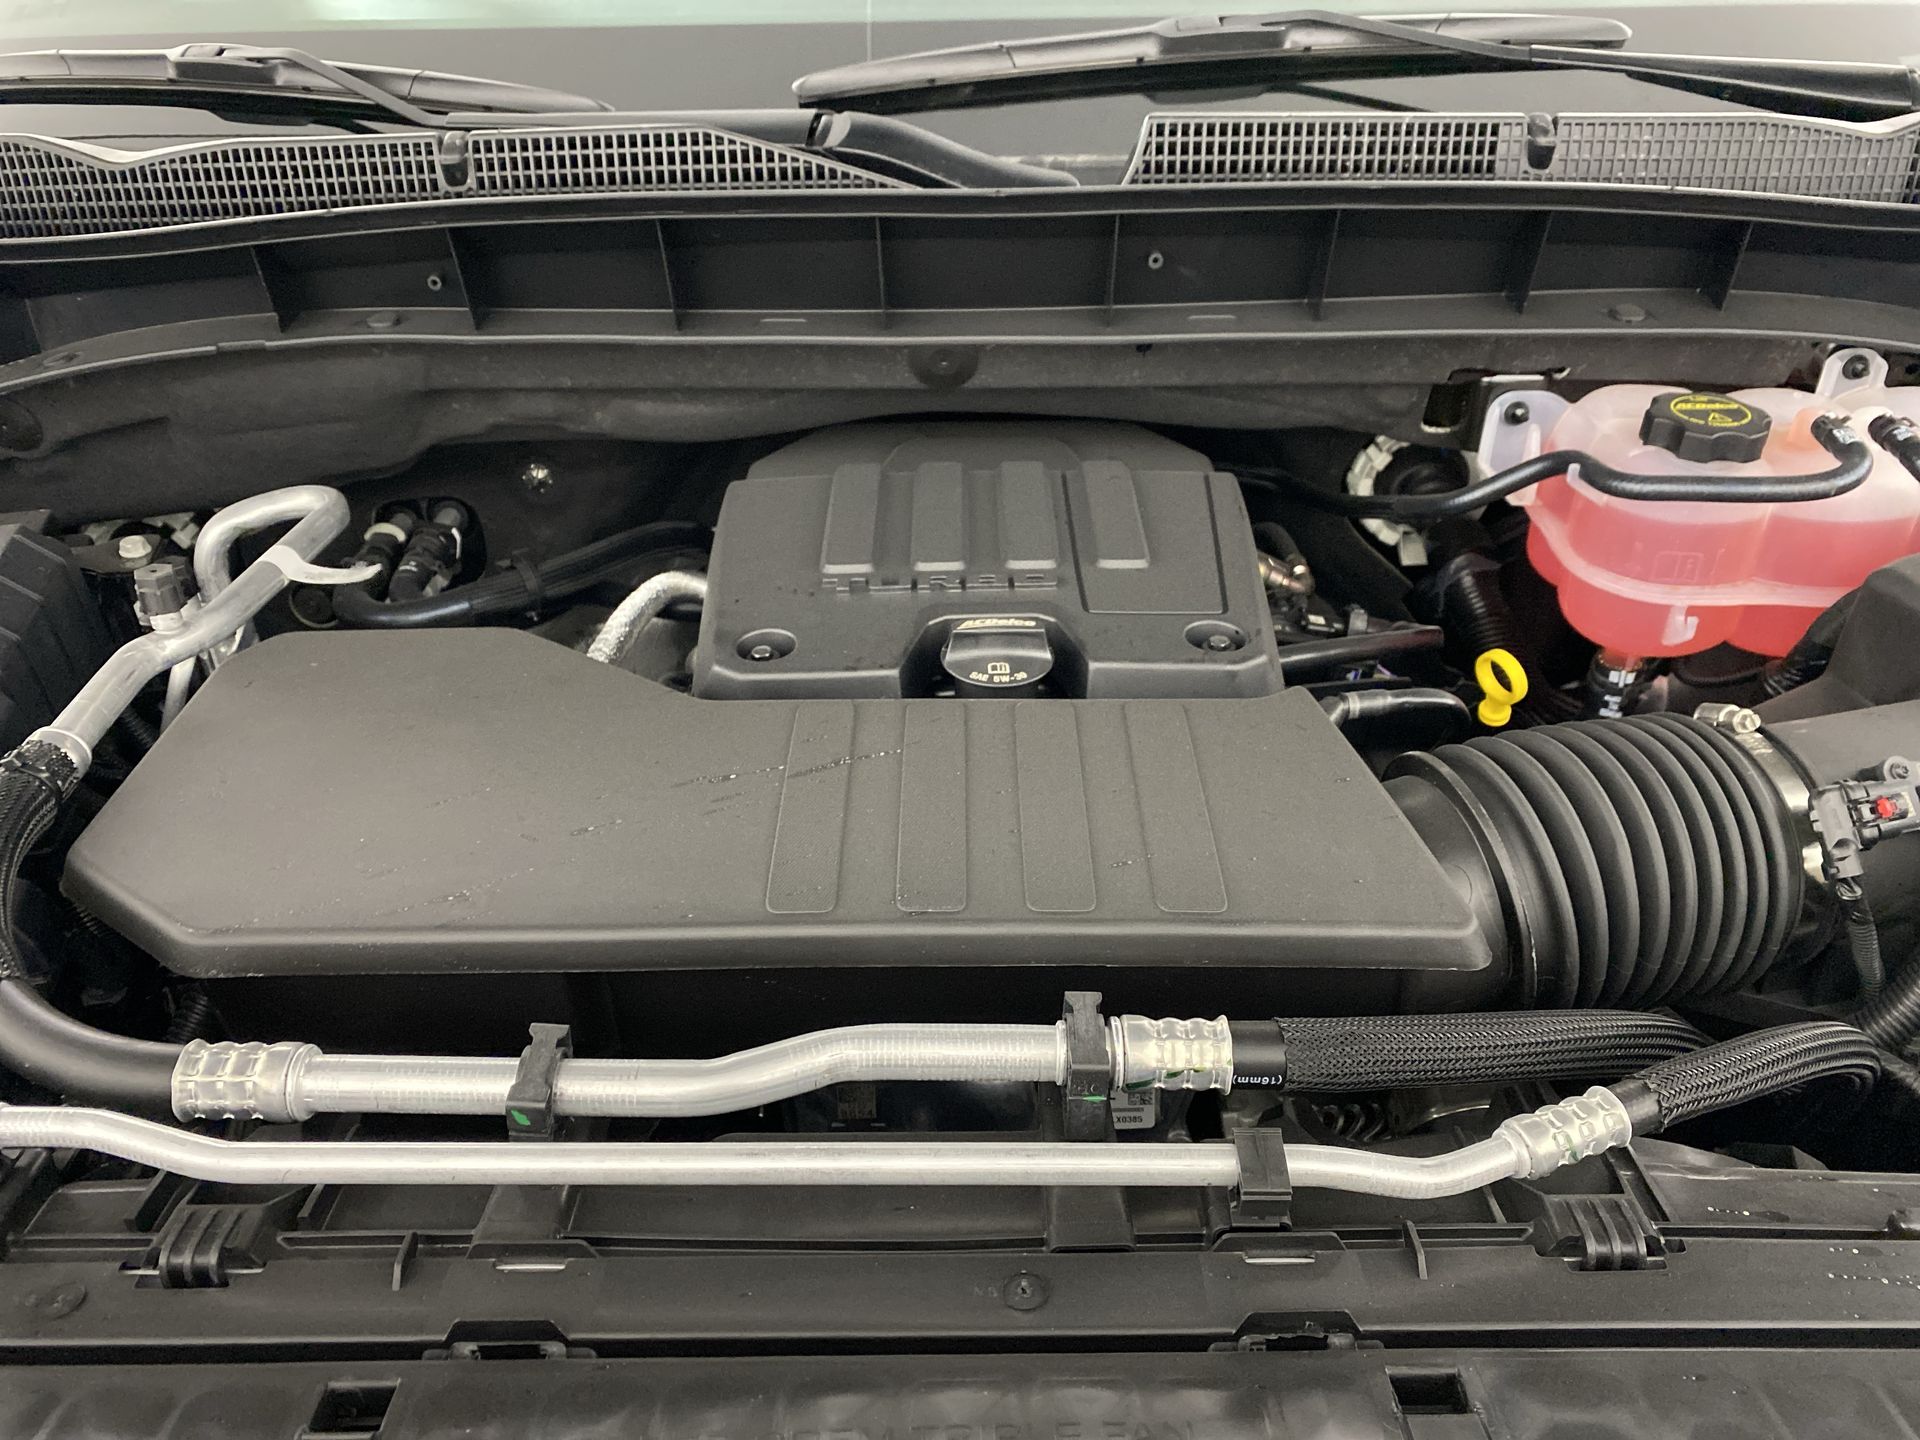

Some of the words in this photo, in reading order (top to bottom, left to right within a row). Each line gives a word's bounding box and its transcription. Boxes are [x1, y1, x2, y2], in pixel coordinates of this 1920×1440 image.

[957, 618, 1037, 629] ACDelco
[969, 671, 990, 682] SAE
[1232, 1074, 1283, 1085] (16mm)
